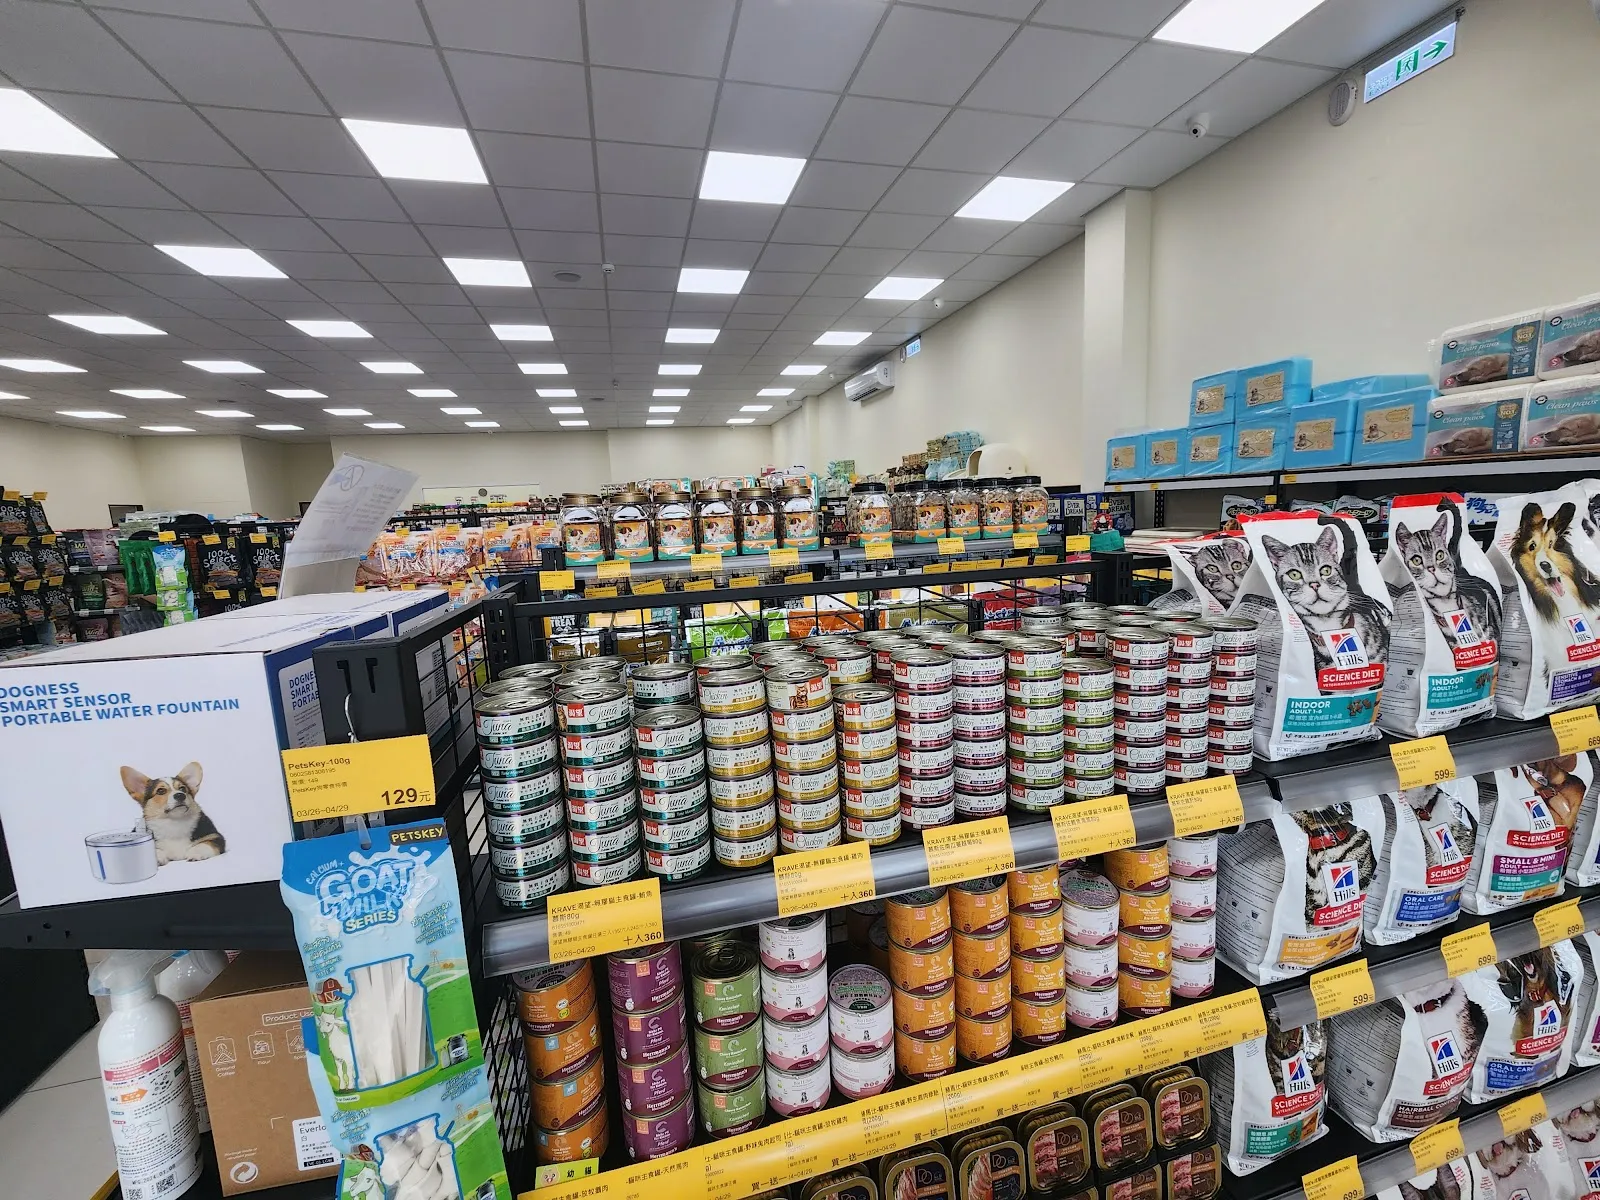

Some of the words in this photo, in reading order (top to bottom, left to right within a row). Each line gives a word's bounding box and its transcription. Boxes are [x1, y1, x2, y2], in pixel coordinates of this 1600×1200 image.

[1561, 320, 1588, 330] Clean
[1457, 343, 1478, 353] Clean
[1546, 401, 1573, 410] Clean
[1574, 398, 1598, 408] paws
[1442, 415, 1464, 424] Clean
[203, 554, 236, 568] Select
[208, 550, 229, 559] 100%
[253, 554, 280, 564] Select
[550, 618, 576, 627] TREAT
[1569, 646, 1593, 657] SCIENCE
[1337, 653, 1364, 667] Hill's
[289, 671, 316, 688] DOGNE
[1323, 672, 1361, 683] SCIENCE
[1362, 669, 1380, 680] DIET
[1432, 677, 1464, 686] INDOOR
[290, 682, 314, 700] SMART
[0, 698, 58, 713] SMART
[63, 693, 131, 708] SENSOR
[1291, 701, 1330, 709] INDOOR
[2, 709, 93, 727] PORTABLE
[97, 705, 153, 720] WATER
[157, 699, 240, 715] FOUNTAIN
[391, 826, 444, 843] PETSKEY
[1513, 834, 1550, 842] SCIENCE
[1551, 831, 1565, 839] DIET
[1540, 854, 1556, 862] MINI
[1430, 867, 1460, 878] SCIENCE
[319, 861, 414, 903] GOAT
[1333, 888, 1356, 902] Hill's
[1319, 905, 1351, 919] SCIENCE
[345, 909, 396, 932] SERIES
[265, 1012, 298, 1023] Product
[1521, 1038, 1552, 1050] SCIENCE
[1437, 1059, 1460, 1074] Hill's
[1490, 1063, 1513, 1072] ORAL
[1289, 1080, 1310, 1093] Hill's
[1274, 1096, 1308, 1110] SCIENCE
[914, 1128, 946, 1142] 買一送一
[831, 1152, 865, 1167] 買一送一
[752, 1175, 787, 1192] 買一送一
